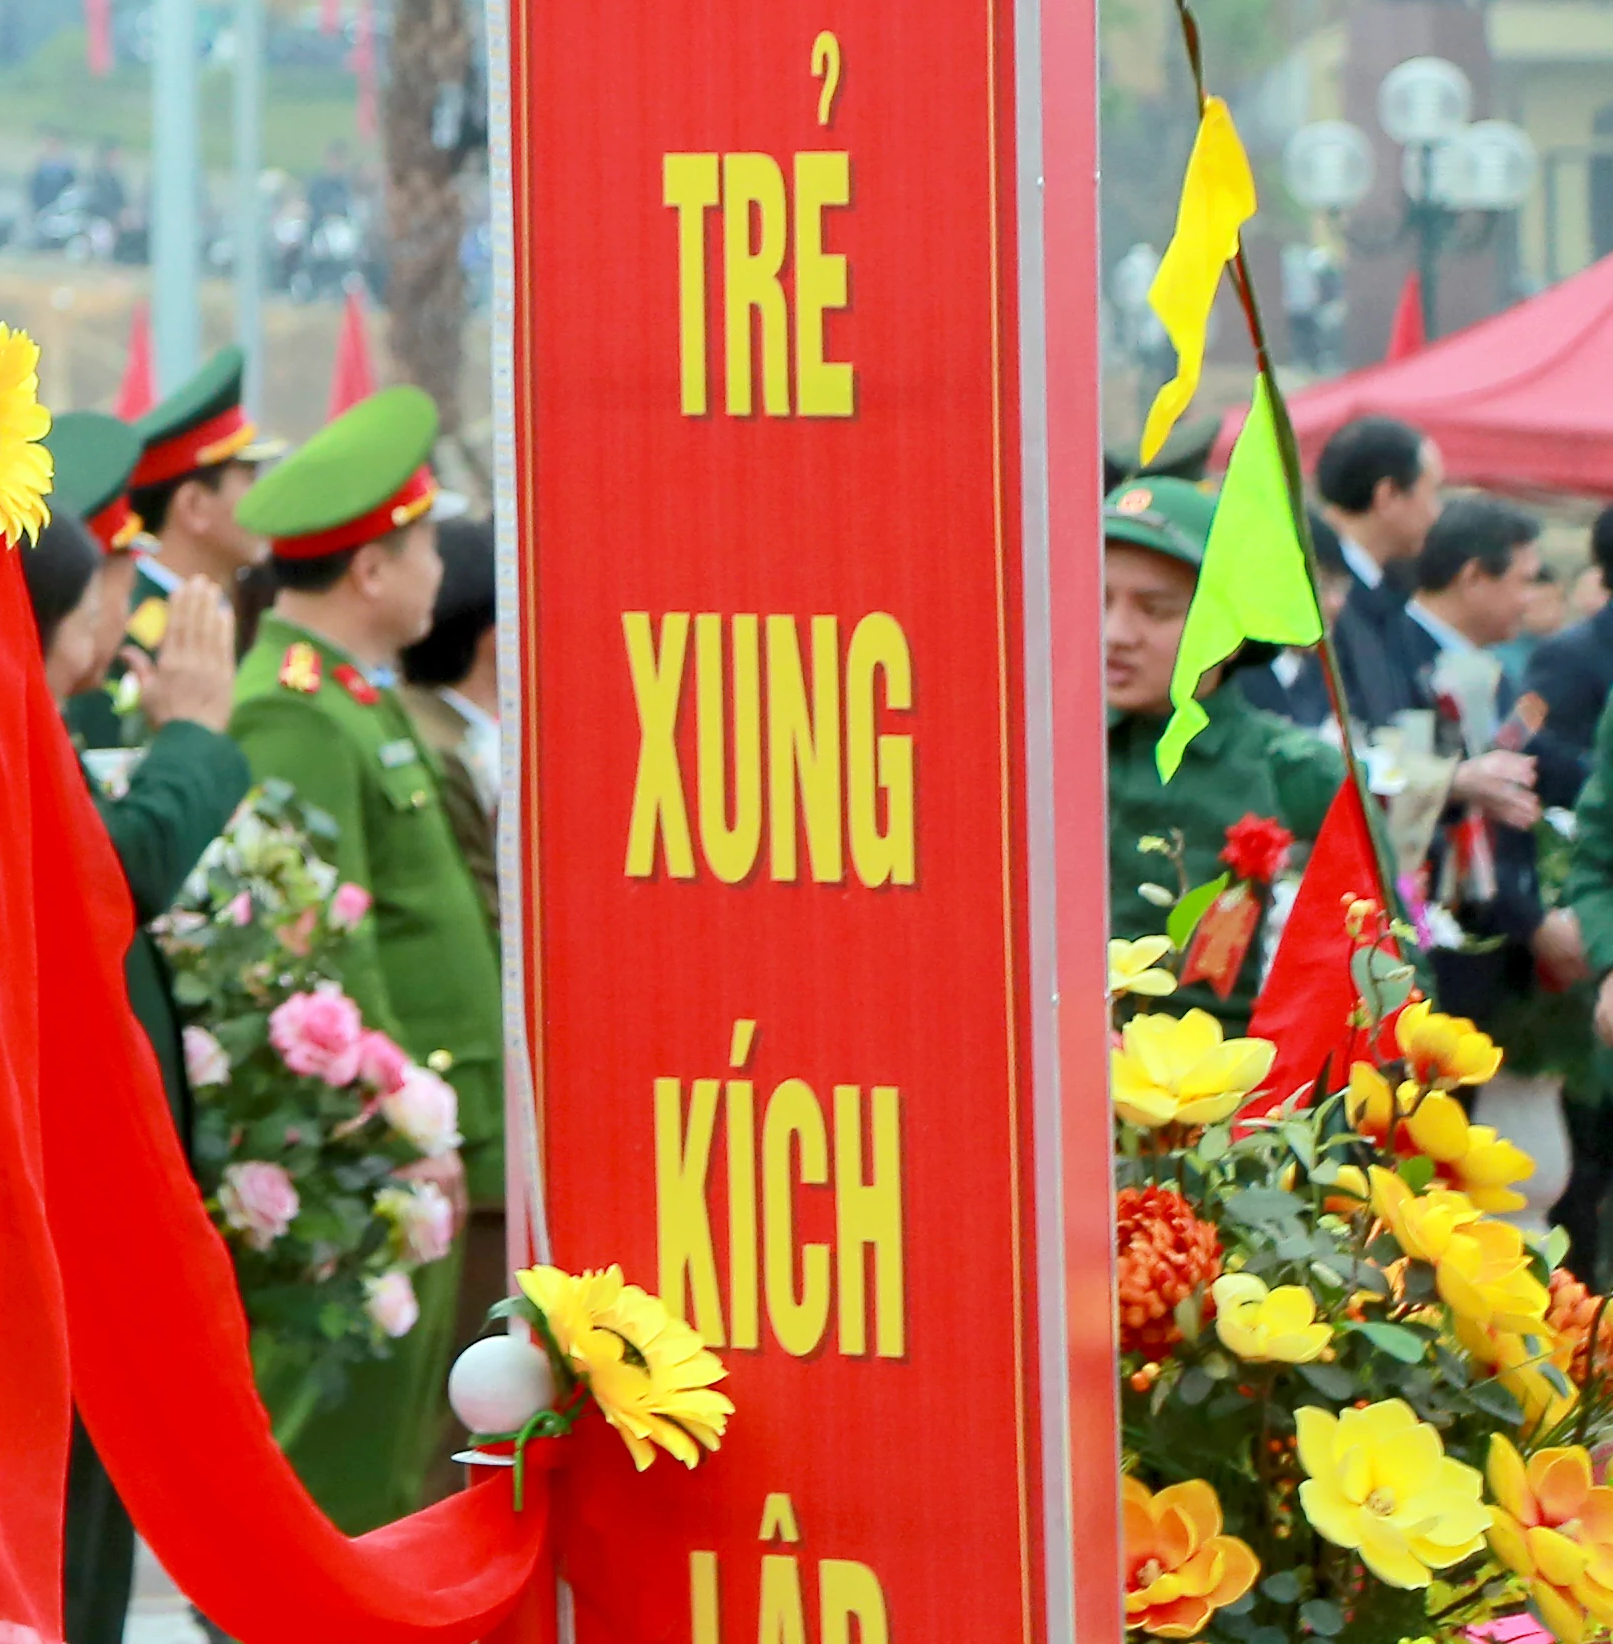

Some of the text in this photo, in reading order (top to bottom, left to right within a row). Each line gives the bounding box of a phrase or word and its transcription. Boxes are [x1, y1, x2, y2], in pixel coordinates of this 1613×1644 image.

[661, 29, 855, 419] TRẺ
[622, 610, 916, 888] XUNG
[653, 1018, 906, 1358] KÍCH
